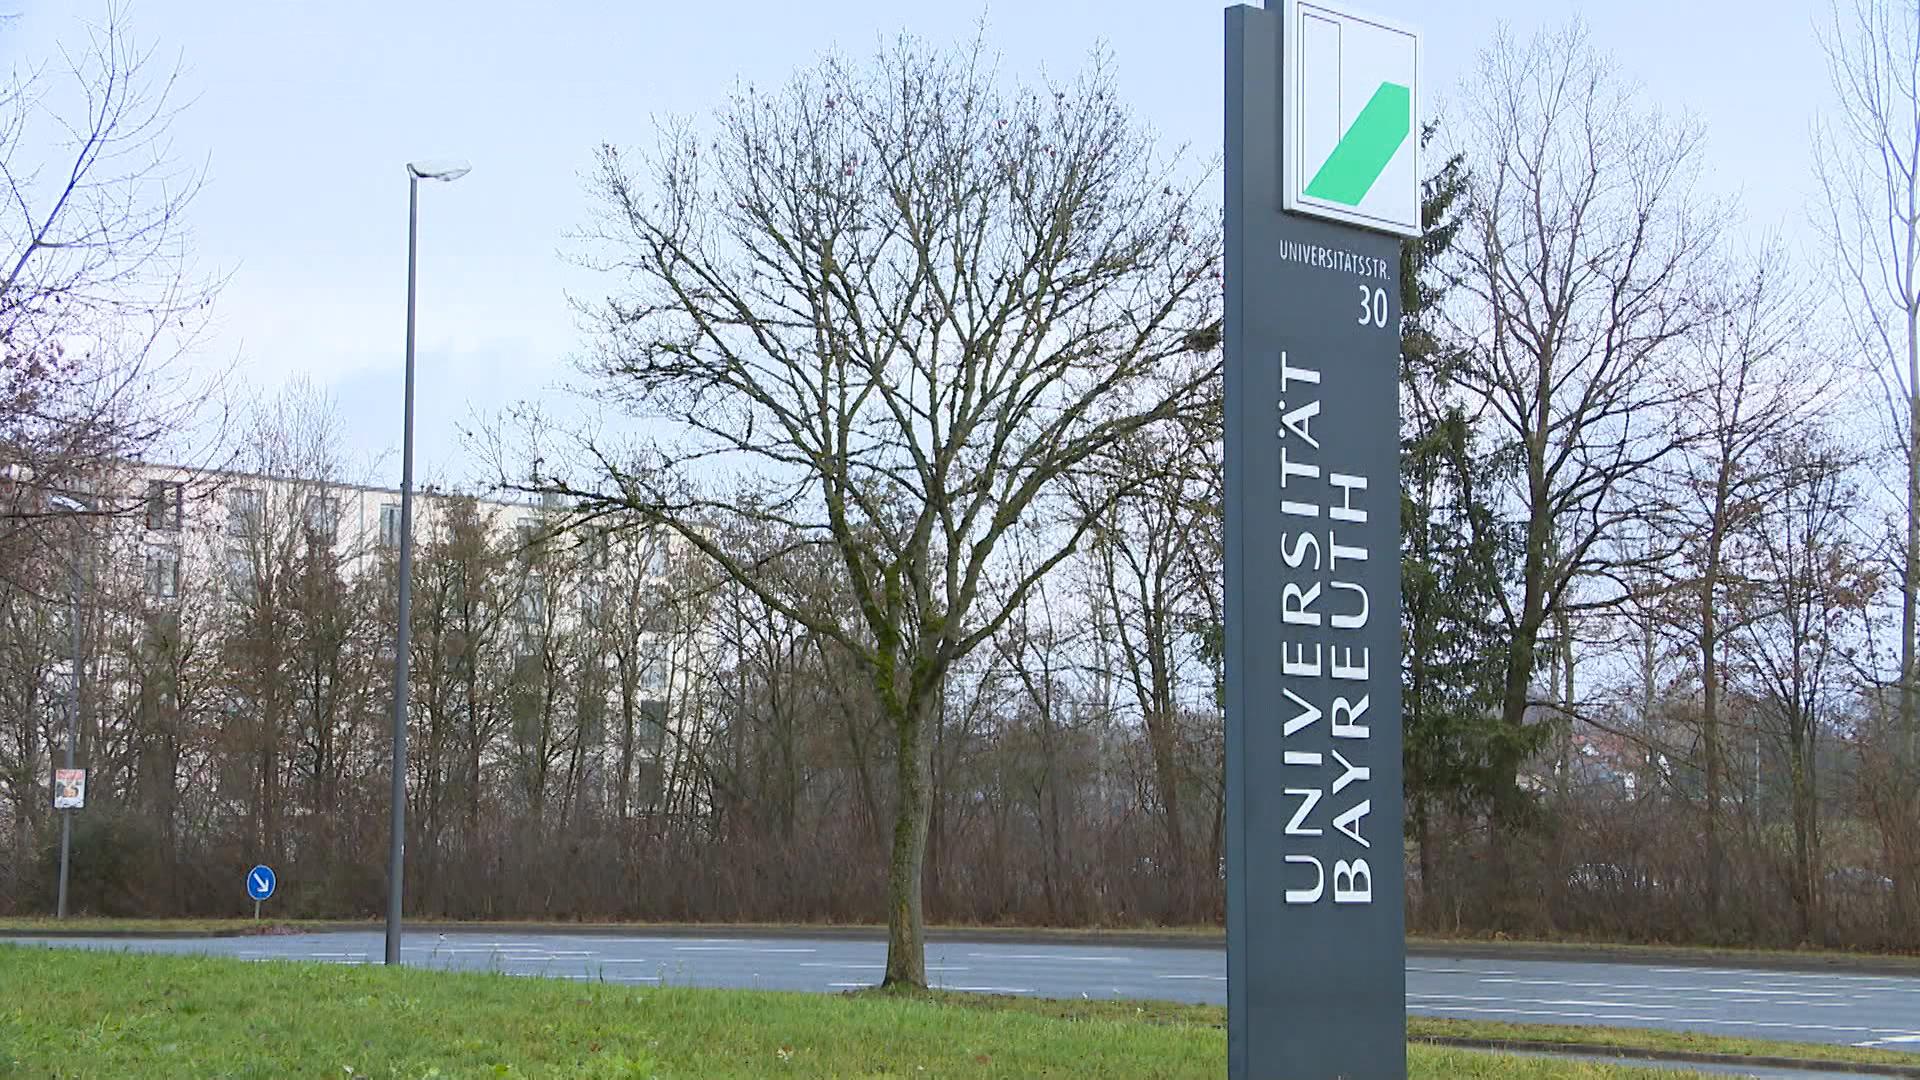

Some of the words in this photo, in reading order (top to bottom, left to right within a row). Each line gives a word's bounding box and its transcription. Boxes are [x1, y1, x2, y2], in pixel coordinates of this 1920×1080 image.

[1279, 239, 1391, 280] UNIVERSITÄTSSTR.
[1357, 284, 1389, 329] 30
[1278, 351, 1324, 904] UNIVERSITÄT
[1329, 472, 1372, 904] BAYREUTH
